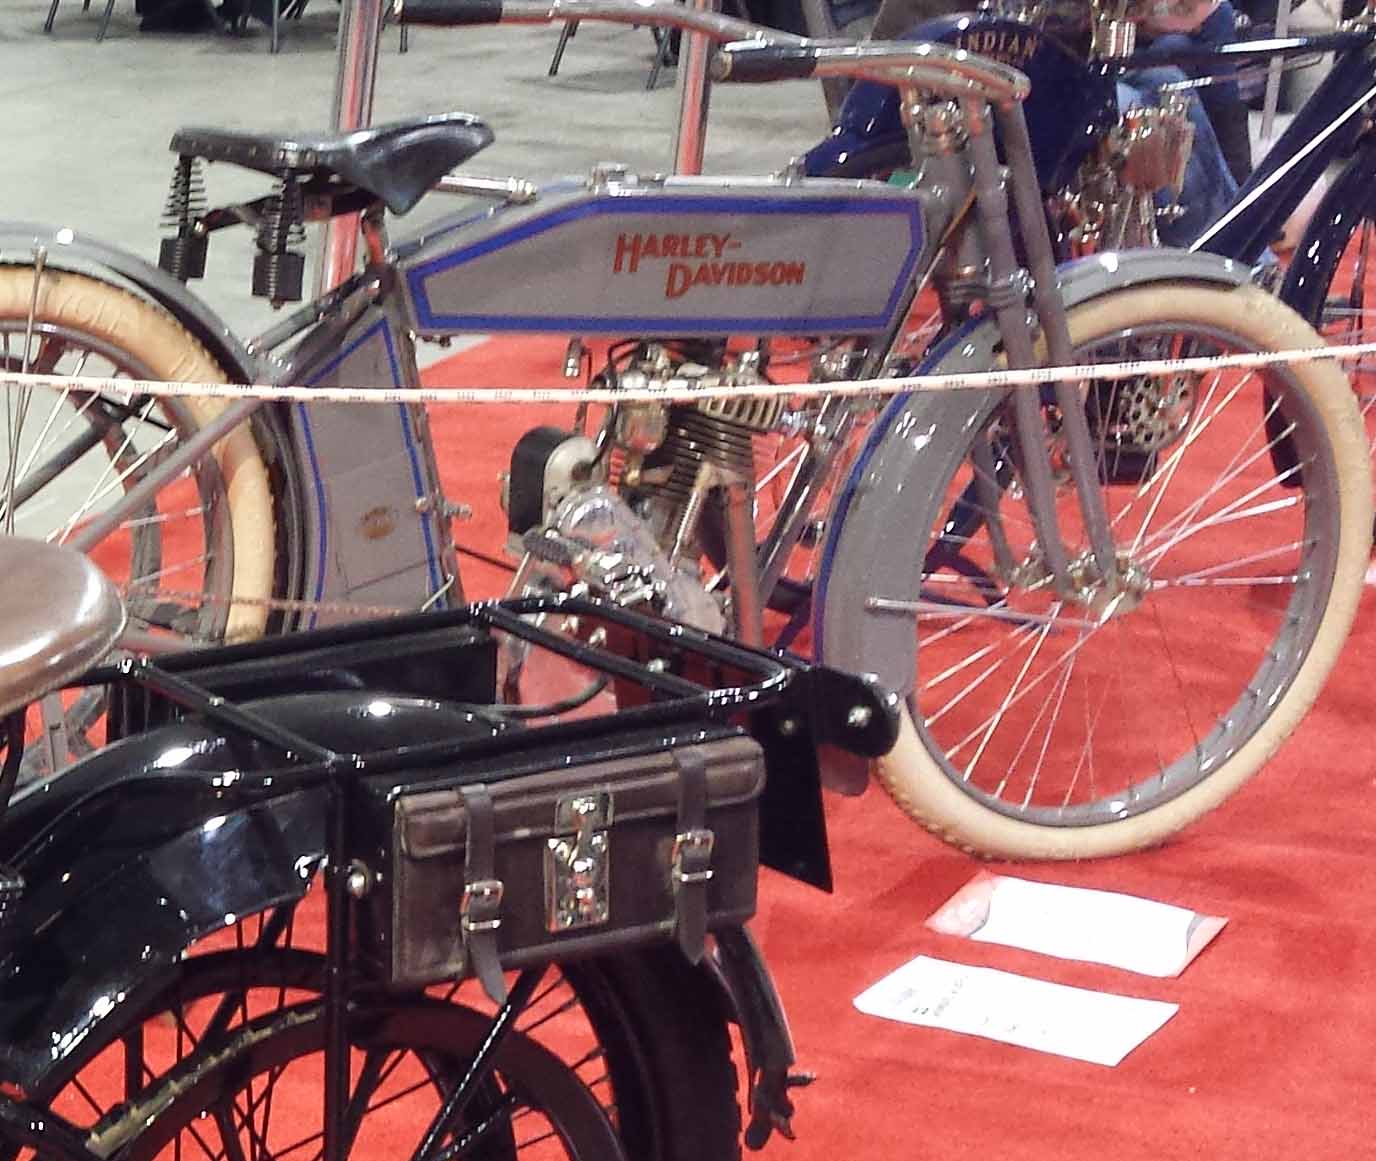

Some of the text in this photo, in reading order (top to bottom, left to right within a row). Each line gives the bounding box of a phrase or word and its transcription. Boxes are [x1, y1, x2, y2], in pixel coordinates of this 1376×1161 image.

[956, 31, 1038, 59] INDIAN
[612, 231, 743, 274] HARLEY-
[664, 261, 806, 298] DAVIDSON
